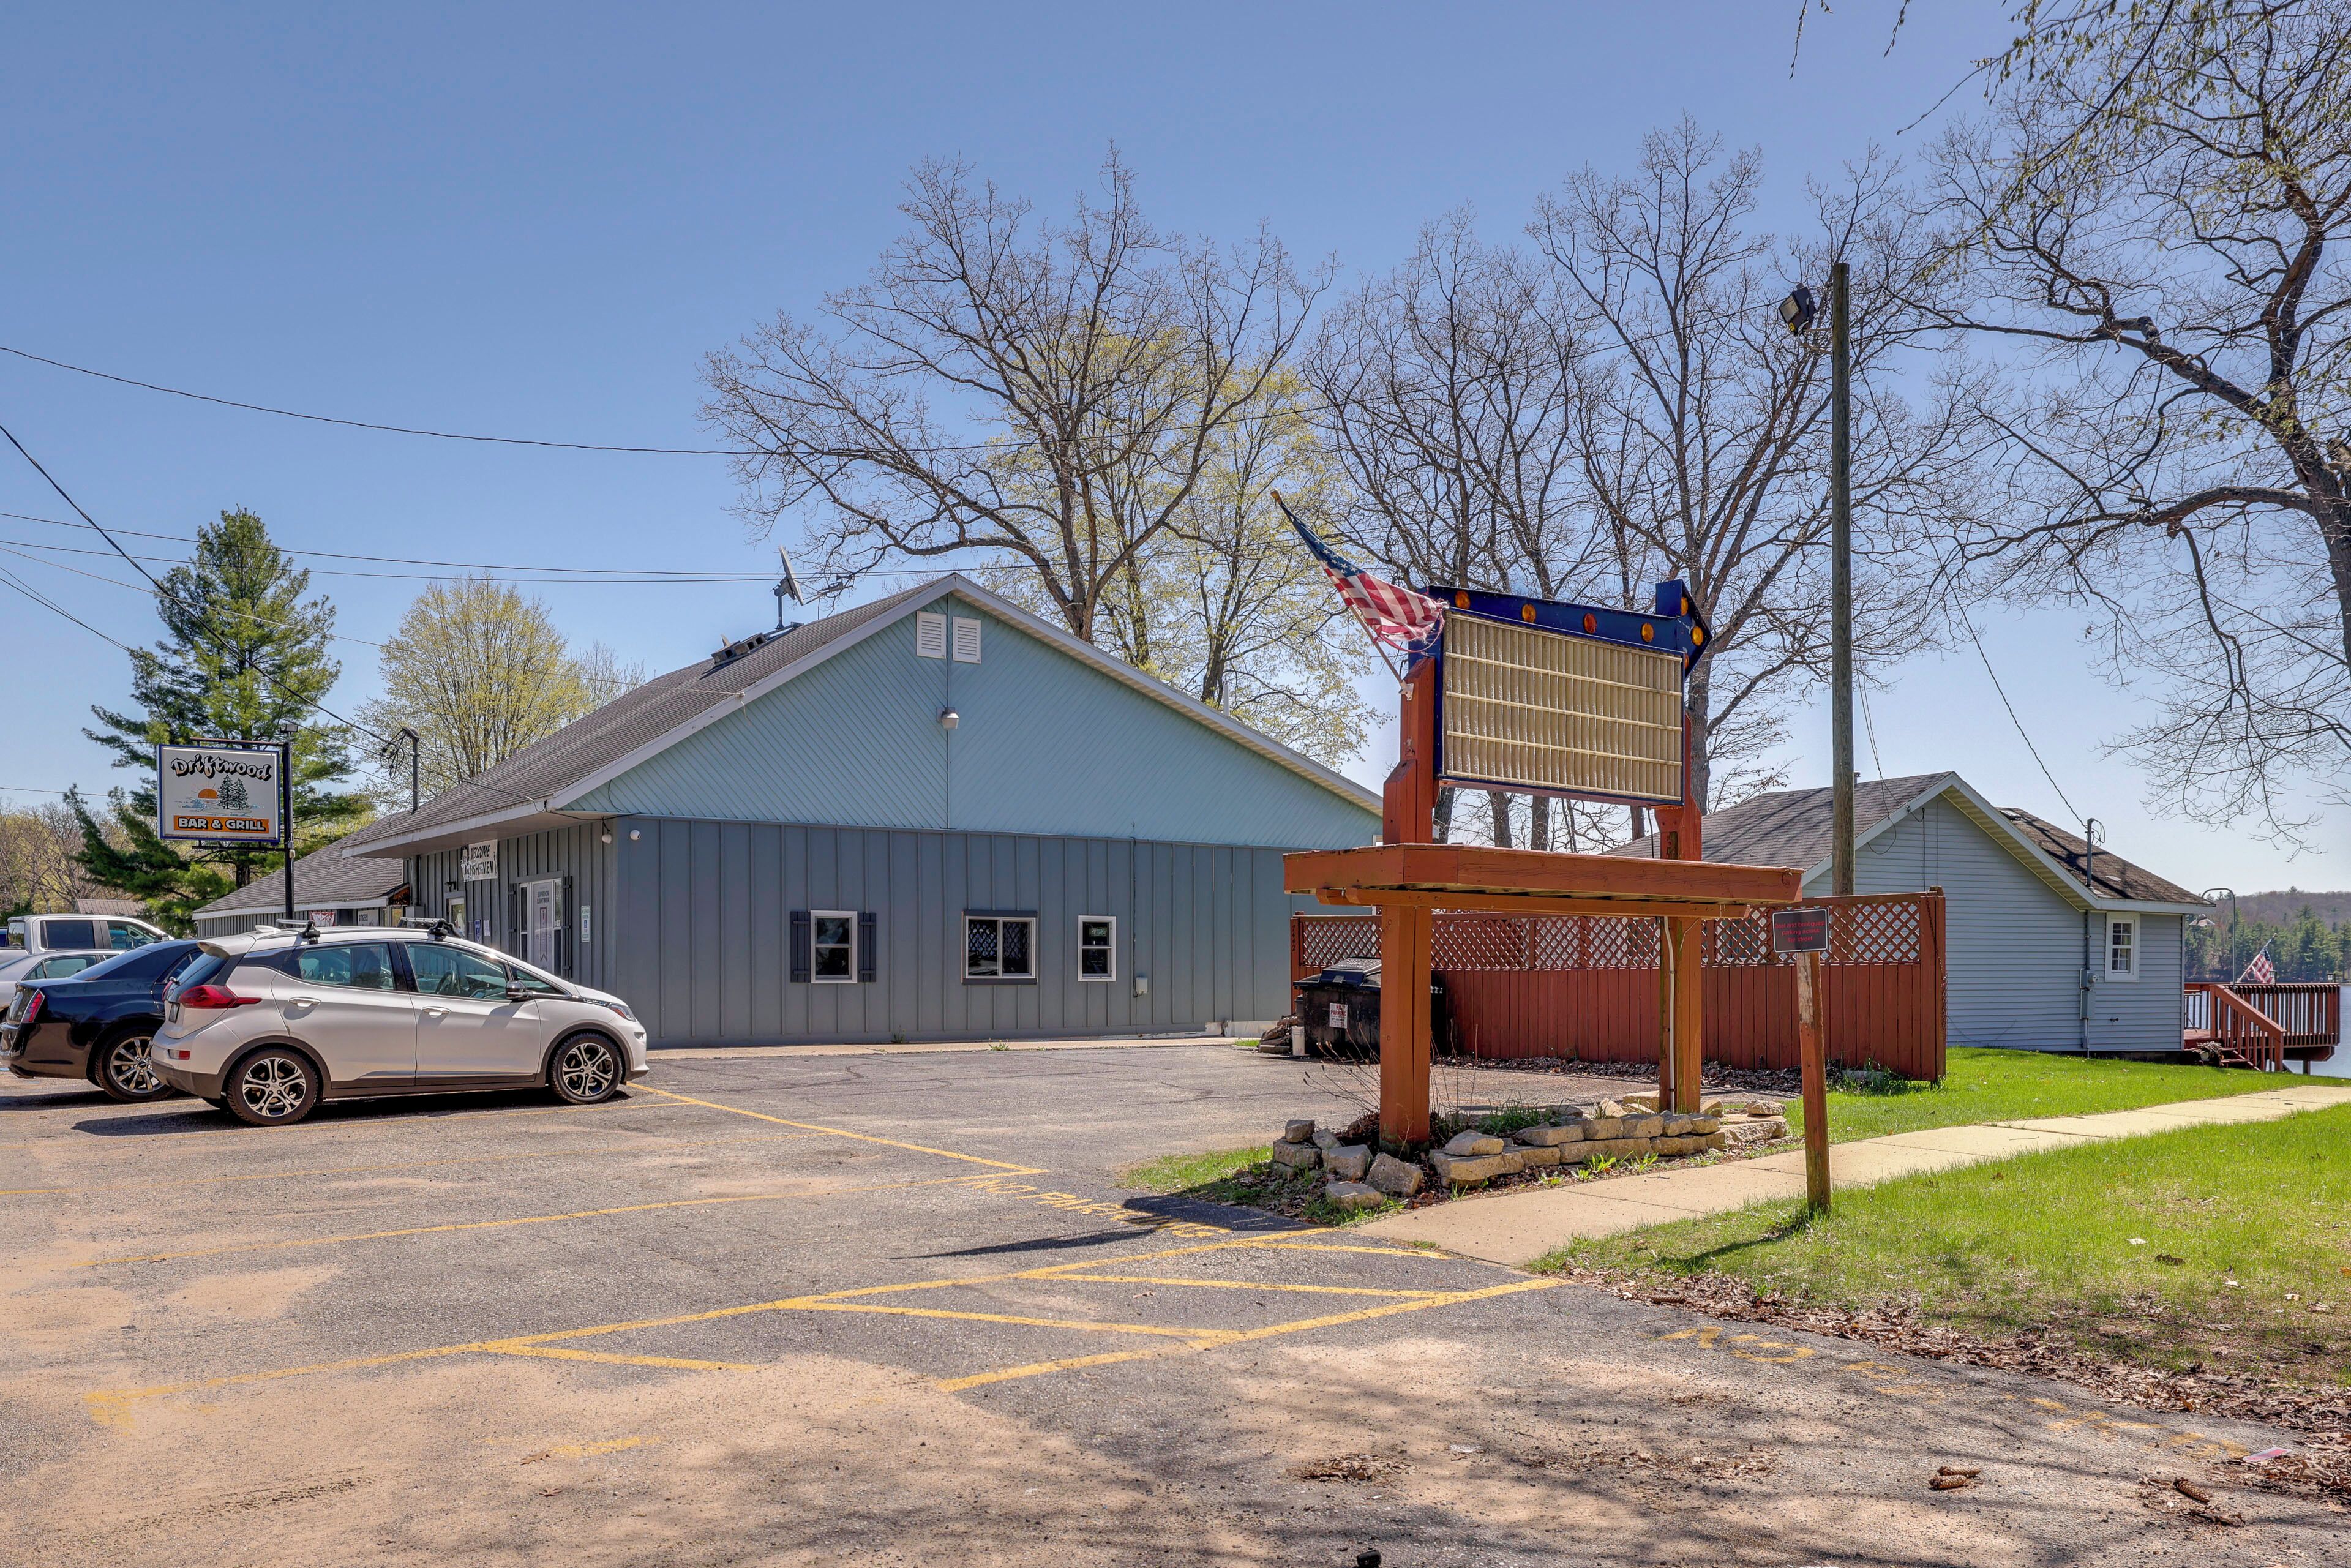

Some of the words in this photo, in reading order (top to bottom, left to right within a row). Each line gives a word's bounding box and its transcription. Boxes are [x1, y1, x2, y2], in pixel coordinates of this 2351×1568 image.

[170, 753, 272, 782] Driftwood
[178, 817, 208, 829] BAR
[211, 819, 223, 830] &
[225, 819, 265, 831] GRILL
[470, 845, 490, 860] WELCOME
[955, 1179, 1037, 1194] NO
[1015, 1191, 1232, 1239] PARKING
